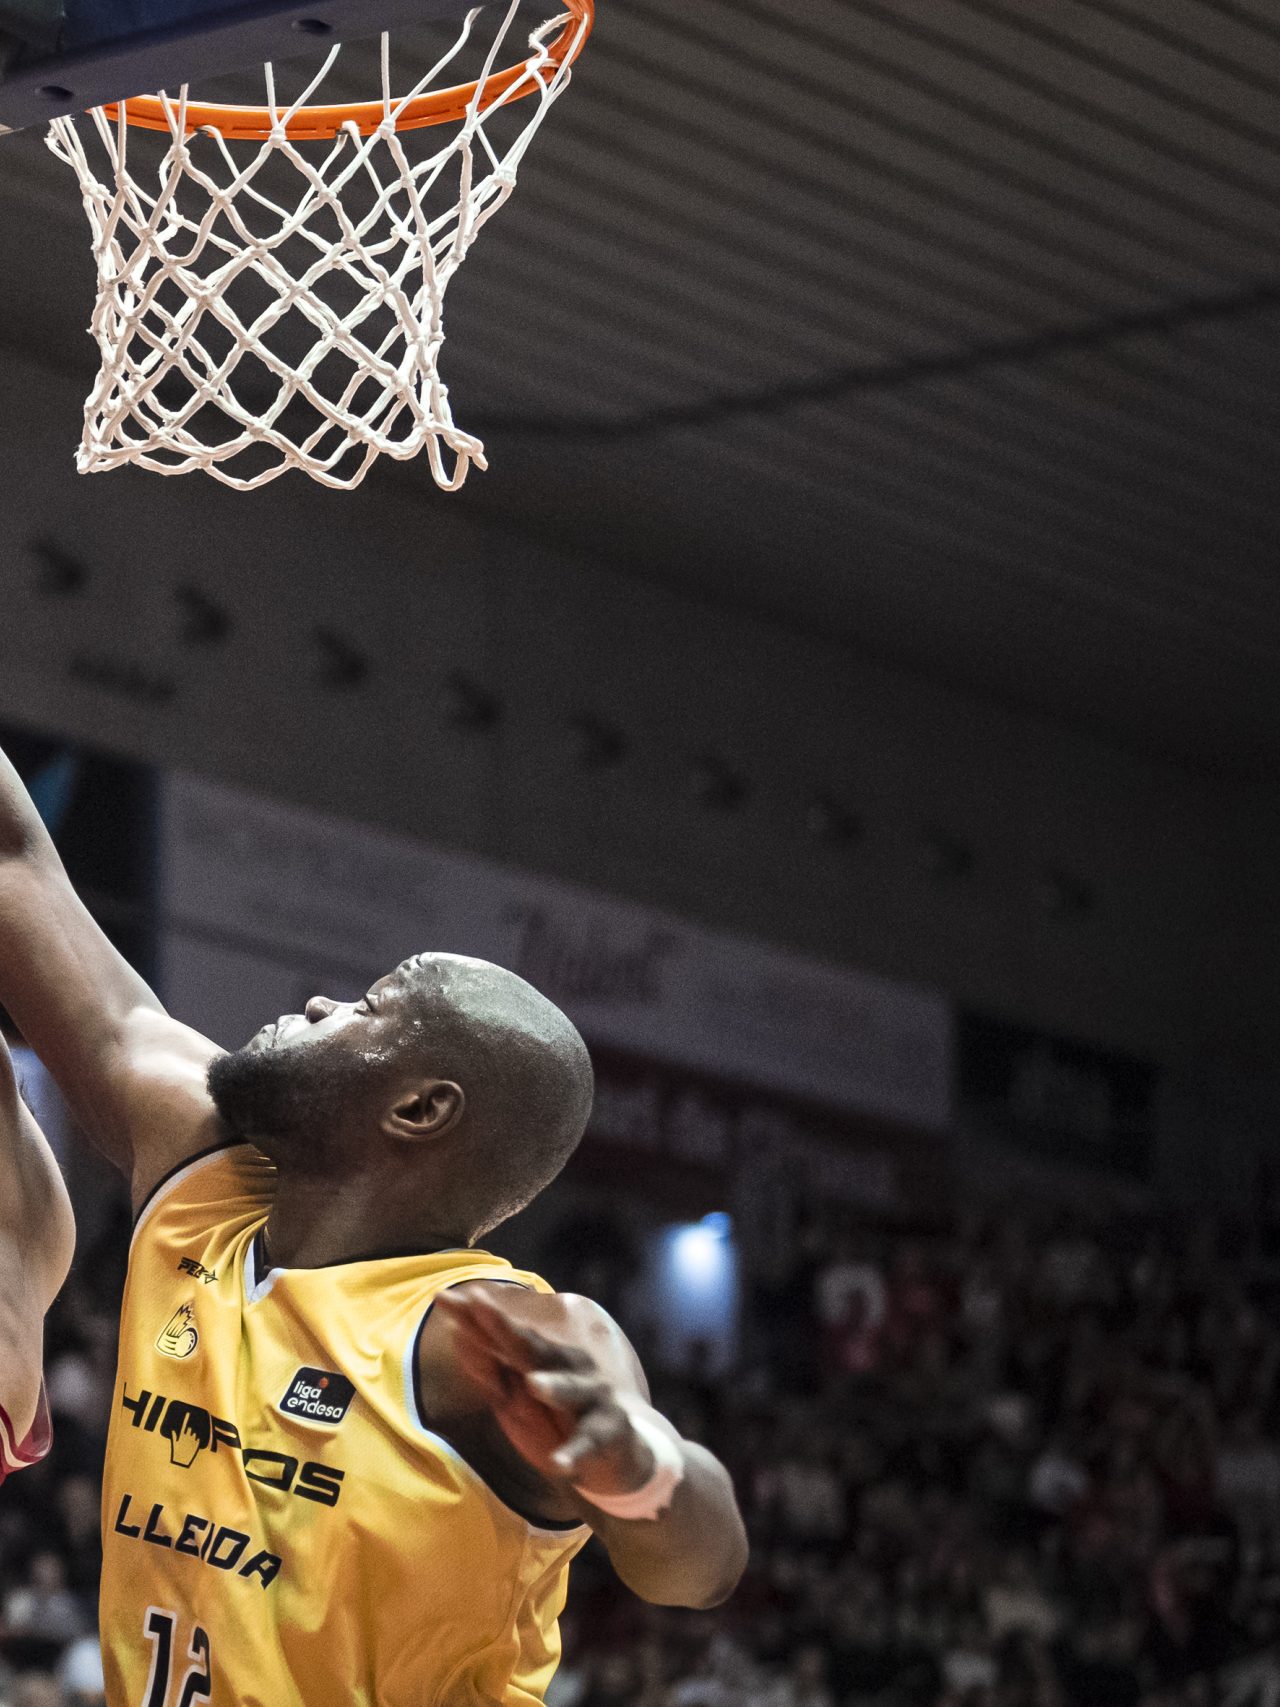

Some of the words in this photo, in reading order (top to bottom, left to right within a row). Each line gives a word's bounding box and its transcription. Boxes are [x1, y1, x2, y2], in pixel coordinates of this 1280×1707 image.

[286, 1396, 345, 1419] endesa
[292, 1380, 323, 1400] liga
[113, 1492, 283, 1591] LLEIDA
[144, 1605, 211, 1707] 12
